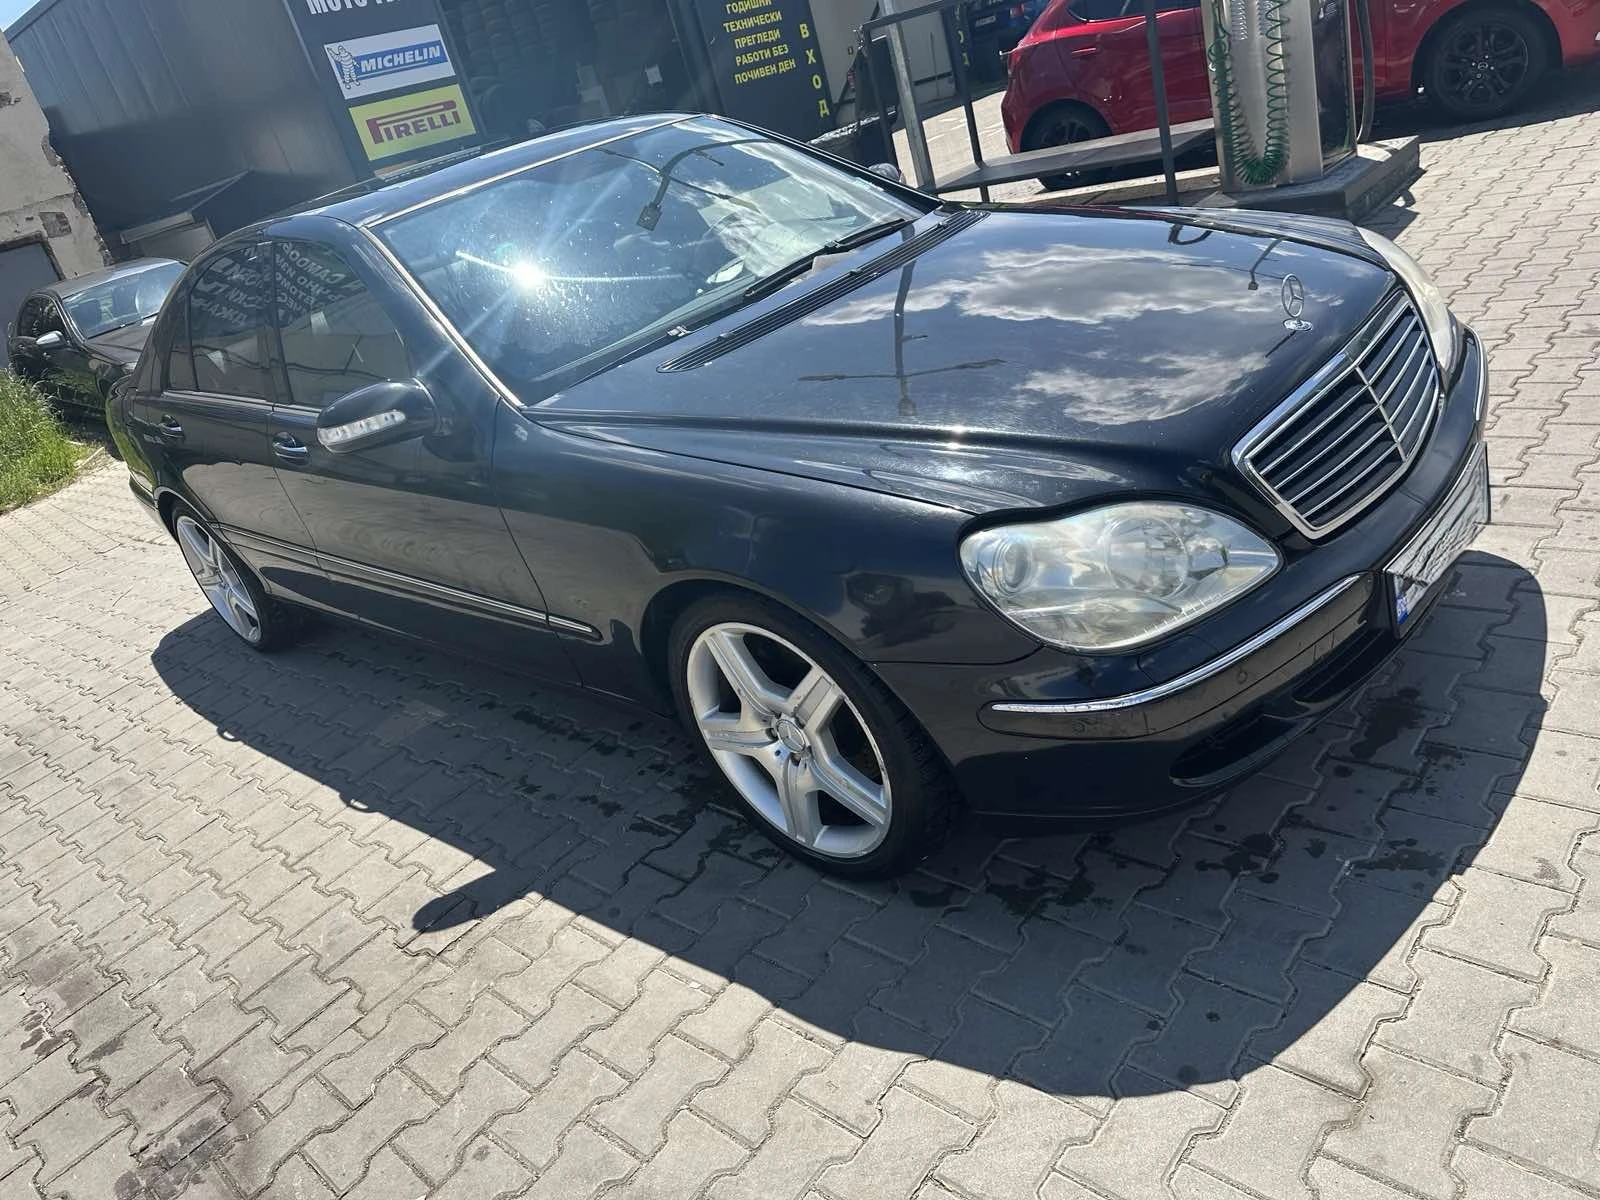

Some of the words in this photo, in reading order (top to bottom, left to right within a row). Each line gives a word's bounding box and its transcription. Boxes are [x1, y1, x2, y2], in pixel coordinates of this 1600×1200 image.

[723, 10, 782, 33] ТЕХНИЧЕСКИ
[734, 29, 781, 49] ПРЕГЛЕДИ
[360, 45, 441, 73] MICHELIN
[735, 49, 771, 67] РАБОТИ
[771, 43, 789, 57] БЕЗ
[734, 64, 777, 84] ПОЧИВЕН
[779, 58, 796, 74] ДЕН
[799, 23, 830, 118] ВХОД
[366, 100, 461, 145] PIRELLI
